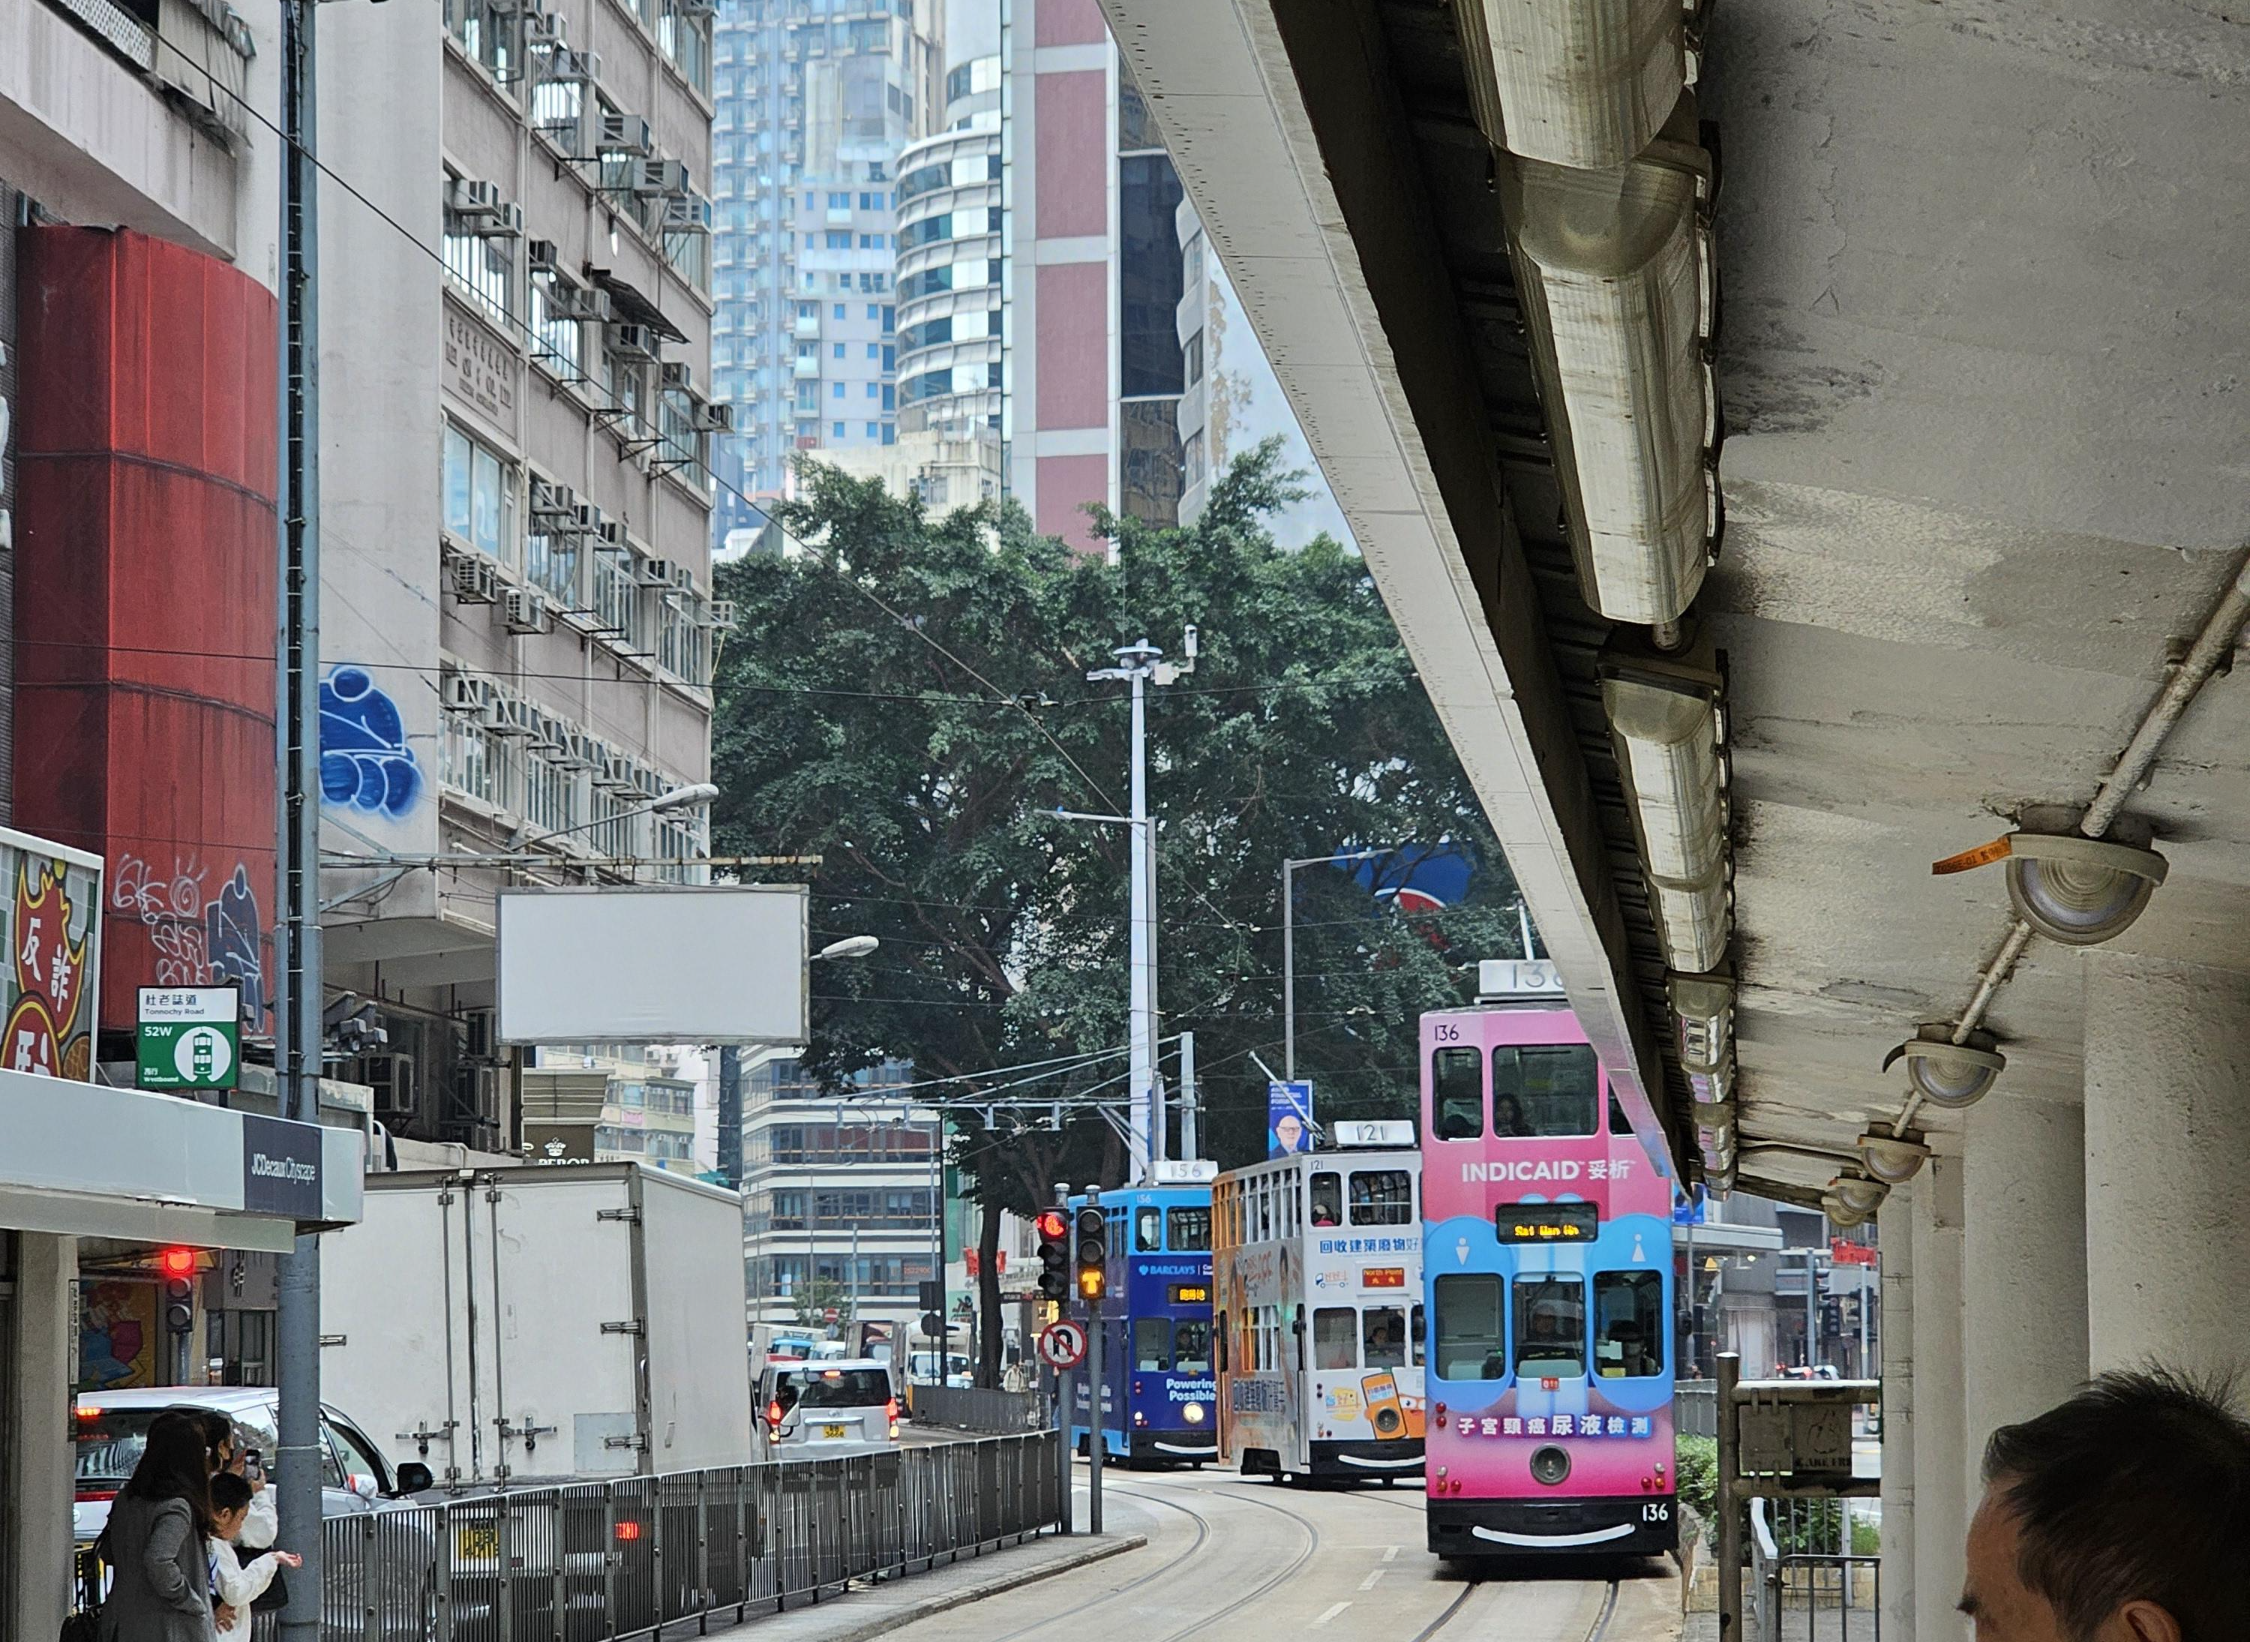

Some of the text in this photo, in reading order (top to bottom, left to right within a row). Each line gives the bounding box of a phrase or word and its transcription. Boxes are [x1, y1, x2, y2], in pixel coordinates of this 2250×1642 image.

[21, 917, 70, 1013] 反詐
[145, 994, 197, 1006] 杜老誌道
[145, 1008, 182, 1016] Tonnochy
[144, 1026, 172, 1037] 52W
[1434, 1024, 1459, 1041] 136
[1355, 1123, 1388, 1142] 121
[251, 1153, 316, 1186] JCDecaux Cityscape
[1170, 1163, 1202, 1178] 156
[1310, 1160, 1324, 1170] 121
[1588, 1160, 1630, 1180] 妥析
[1136, 1195, 1152, 1204] 156
[1150, 1265, 1196, 1275] BARCLAYS
[1169, 1390, 1216, 1401] Possible
[1457, 1414, 1650, 1436] 子宮頸癌尿液檢測
[1642, 1503, 1669, 1522] 136
